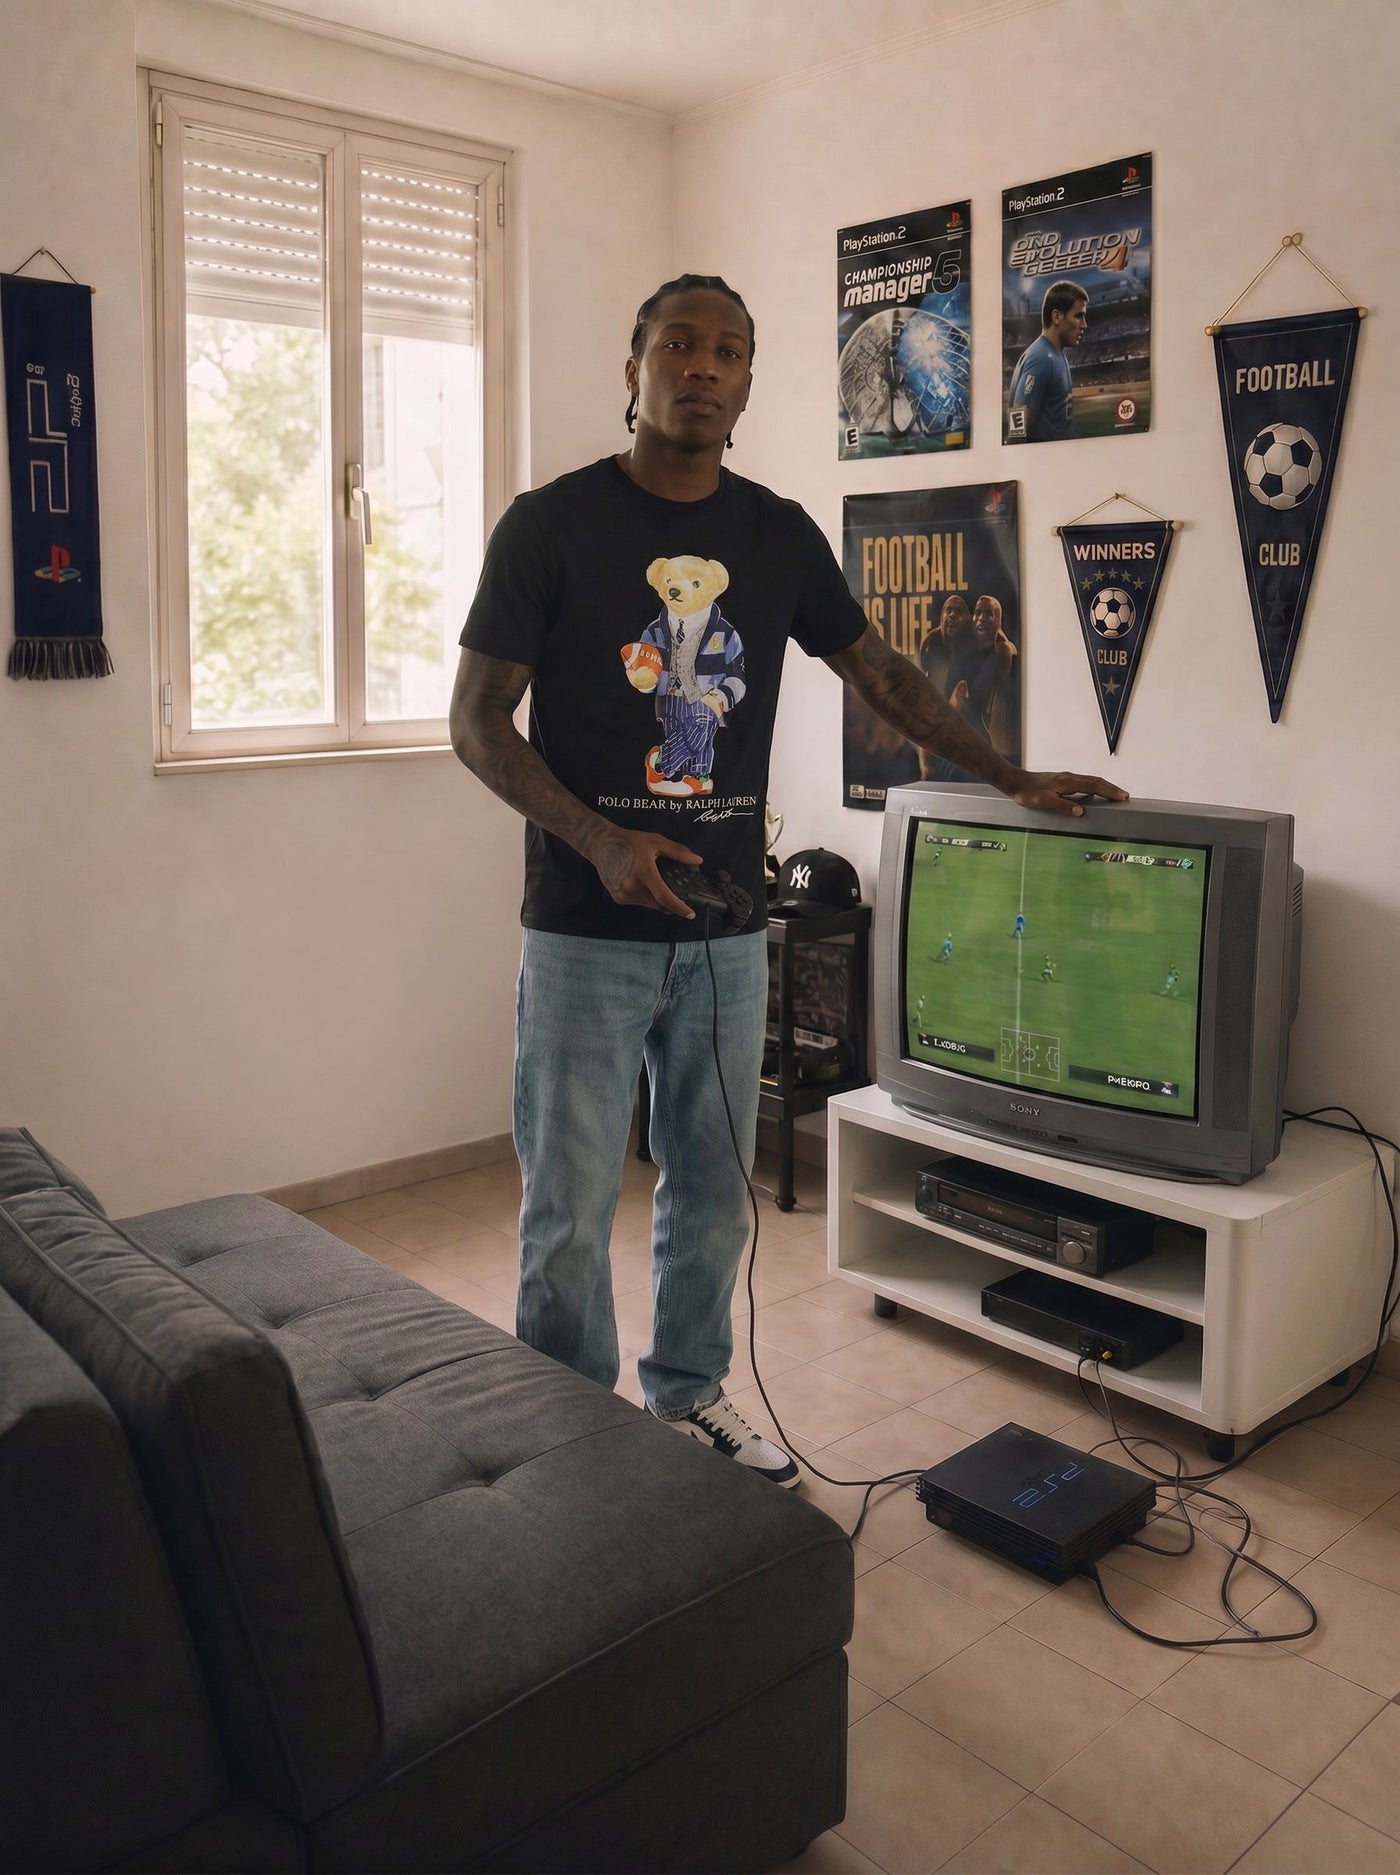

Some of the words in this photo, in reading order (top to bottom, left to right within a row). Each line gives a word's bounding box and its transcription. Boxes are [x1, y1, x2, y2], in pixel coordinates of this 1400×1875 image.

[844, 256, 932, 285] CHAMPIONSHIP
[843, 271, 933, 307] manager
[1235, 359, 1335, 394] FOOTBALL
[1073, 542, 1156, 561] WINNERS
[1259, 543, 1300, 566] CLUB
[862, 532, 968, 595] FOOTBALL
[1097, 649, 1128, 666] CLUB
[598, 796, 630, 808] POLO
[633, 799, 667, 810] BEAR
[669, 801, 683, 813] by
[686, 798, 721, 811] RALPH
[1009, 1102, 1040, 1116] SONY
